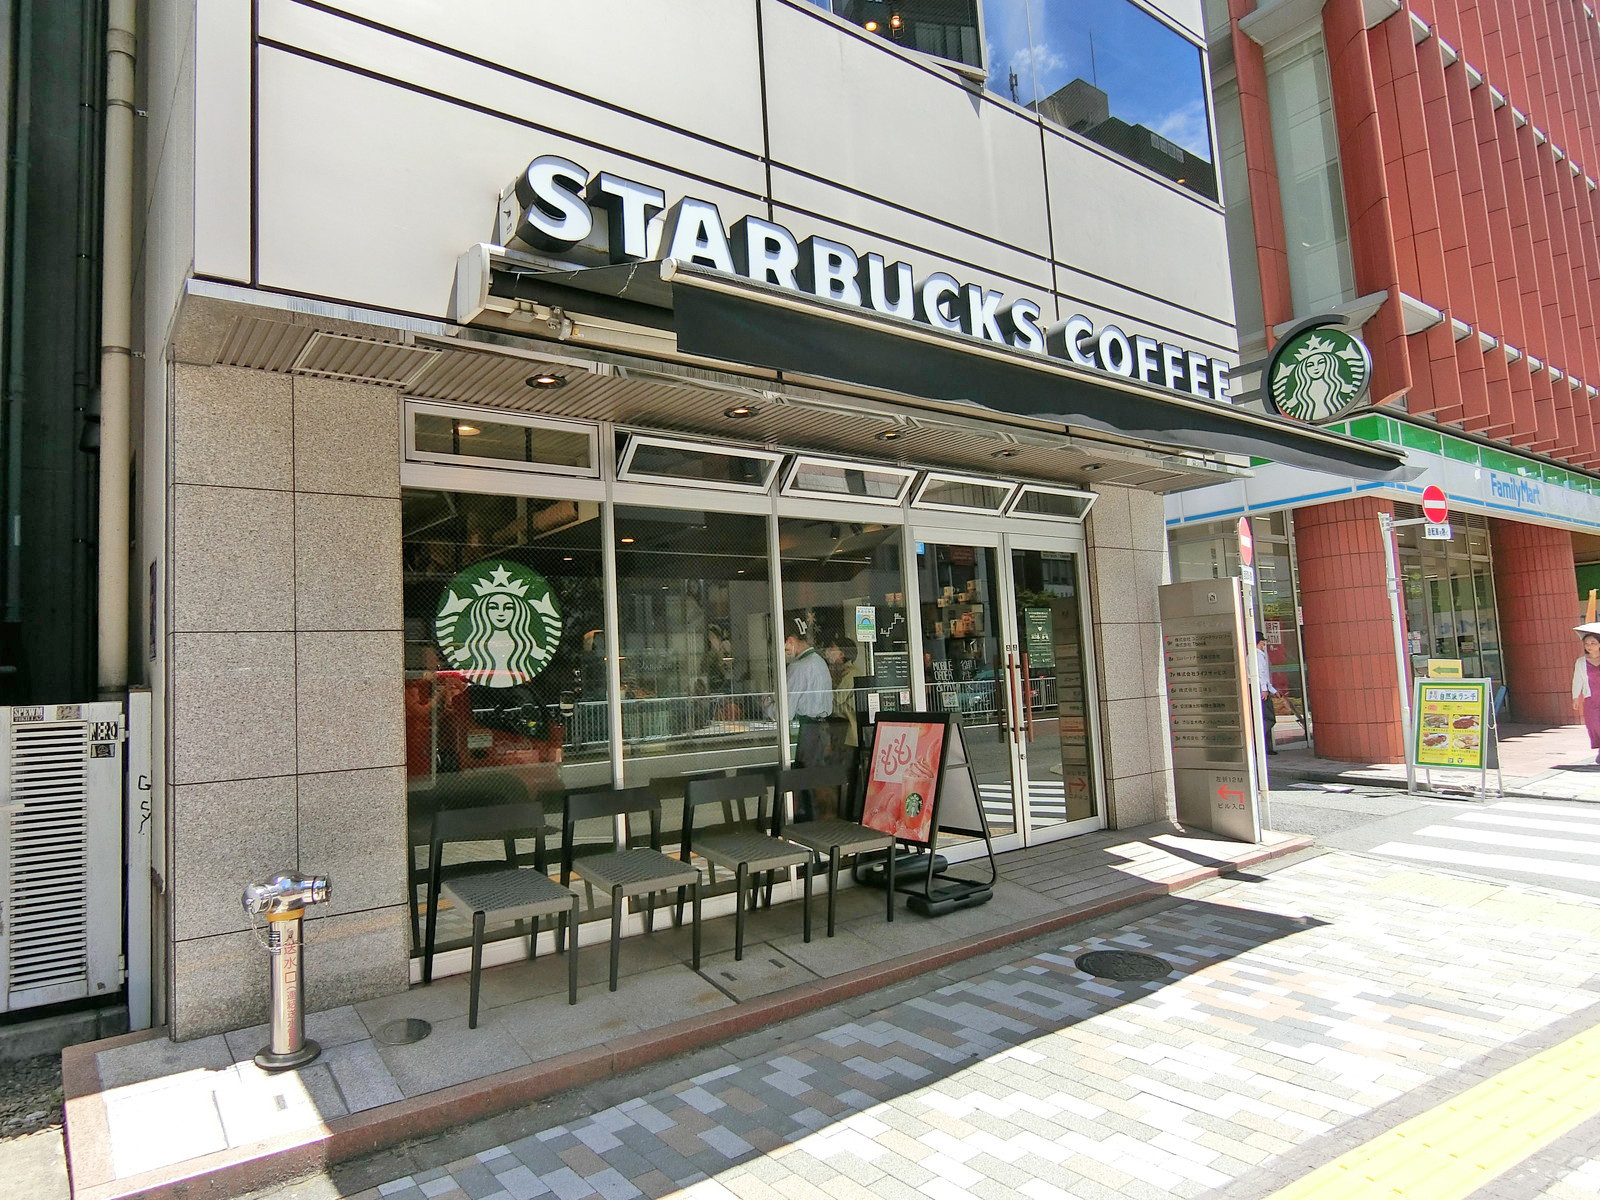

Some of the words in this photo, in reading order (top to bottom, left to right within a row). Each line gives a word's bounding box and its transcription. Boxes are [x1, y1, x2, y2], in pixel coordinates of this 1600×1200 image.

[523, 154, 1047, 357] STARBUCKS
[1063, 313, 1231, 405] COFFEE
[1490, 472, 1541, 507] FamilyMart
[1217, 802, 1246, 810] ビル入口
